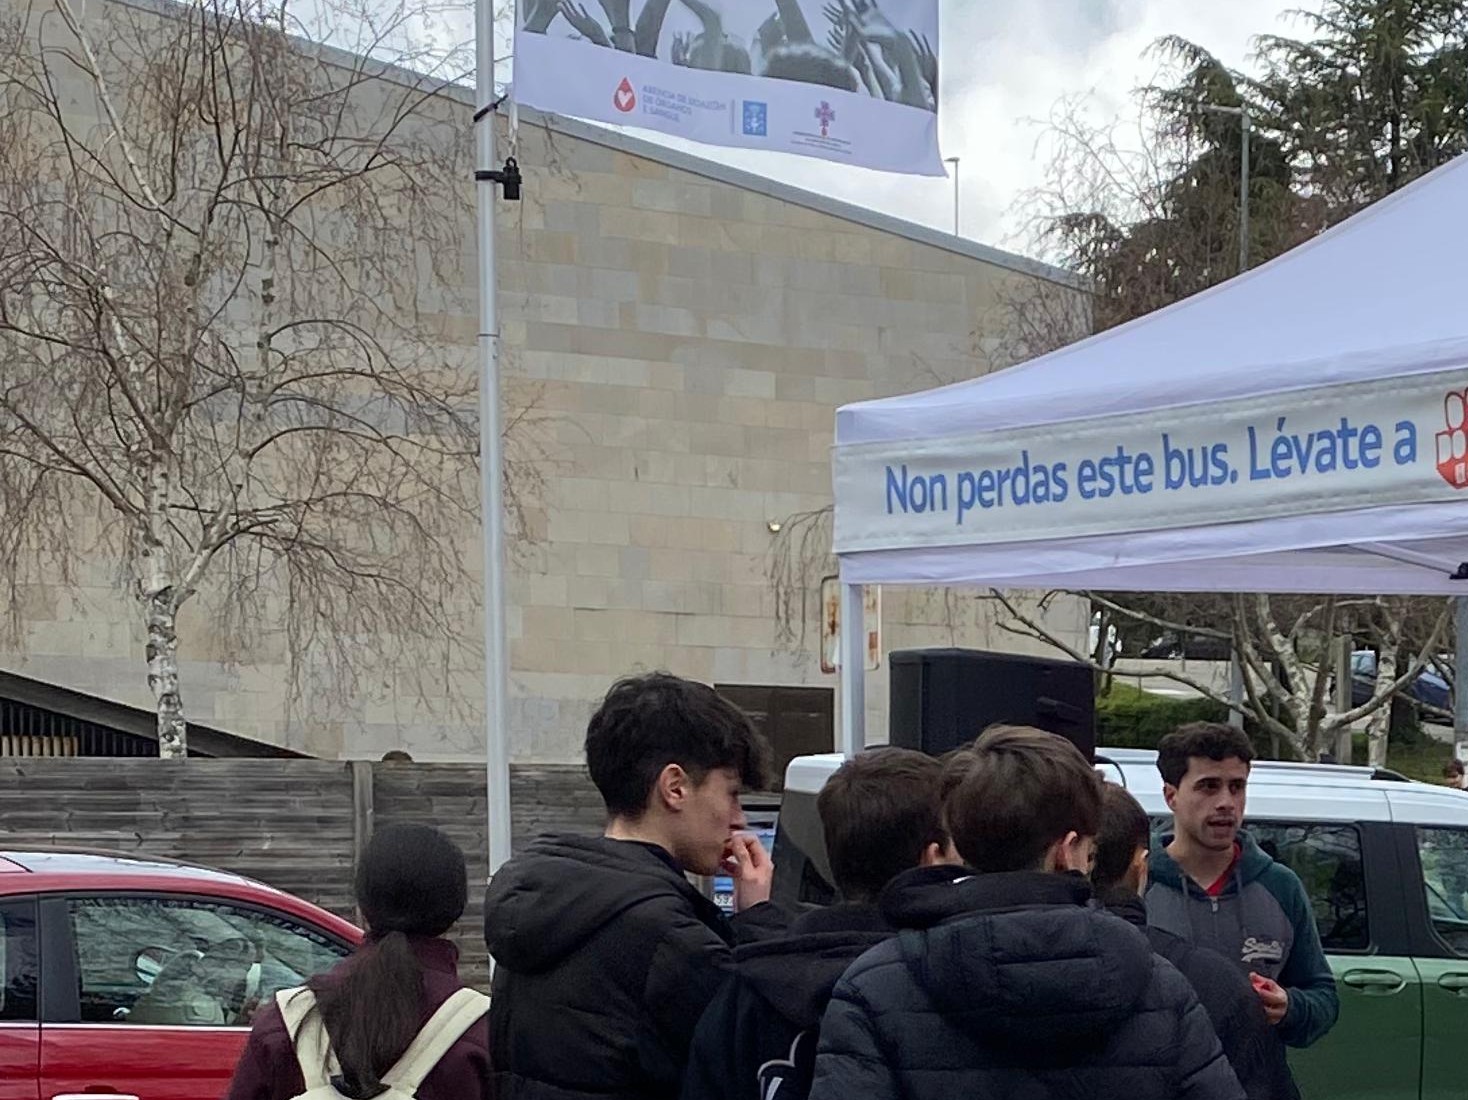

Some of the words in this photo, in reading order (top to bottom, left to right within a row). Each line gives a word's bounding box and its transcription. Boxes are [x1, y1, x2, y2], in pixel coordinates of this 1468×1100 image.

[1446, 392, 1465, 430] O
[1437, 430, 1467, 464] DO
[886, 466, 948, 514] Non
[957, 451, 1068, 525] perdas
[1077, 447, 1154, 499] este
[1162, 434, 1238, 491] bus.
[1247, 417, 1382, 481] Lévate
[1393, 420, 1417, 464] a
